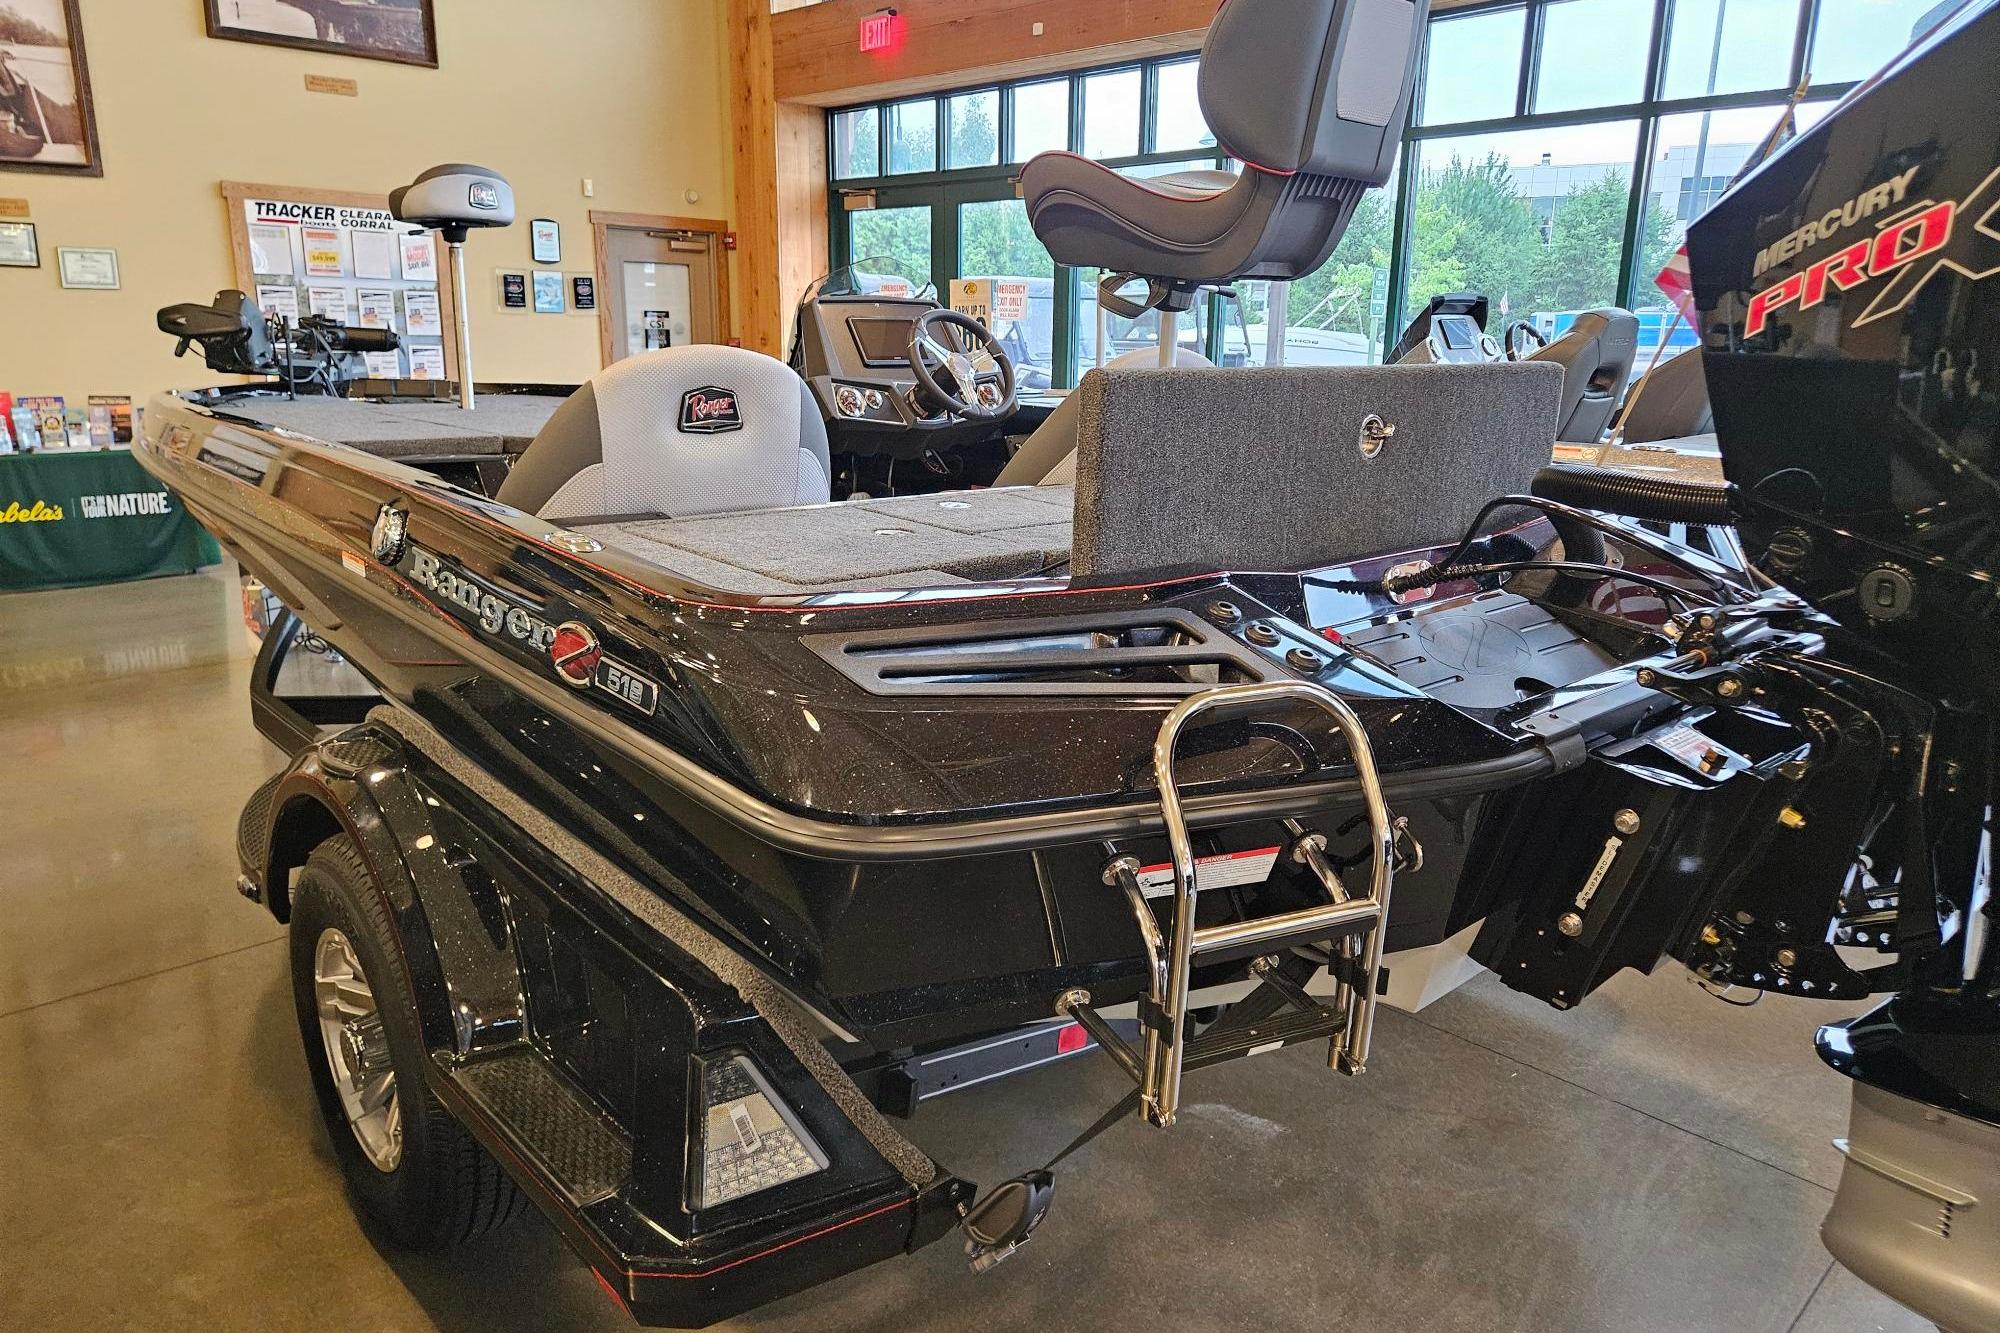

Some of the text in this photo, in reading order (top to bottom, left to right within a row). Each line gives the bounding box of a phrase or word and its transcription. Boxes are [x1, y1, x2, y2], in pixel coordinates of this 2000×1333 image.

[865, 18, 887, 49] EXIT
[255, 202, 393, 222] TRACKER CLEARA
[1753, 165, 1920, 278] MERCURY
[341, 219, 394, 231] CORRAL
[1743, 201, 1957, 340] PRO
[997, 284, 1026, 294] MERGENCY
[979, 304, 986, 316] TO
[688, 394, 734, 421] Ranger
[409, 546, 557, 653] Ranger
[1201, 853, 1233, 864] DANGER
